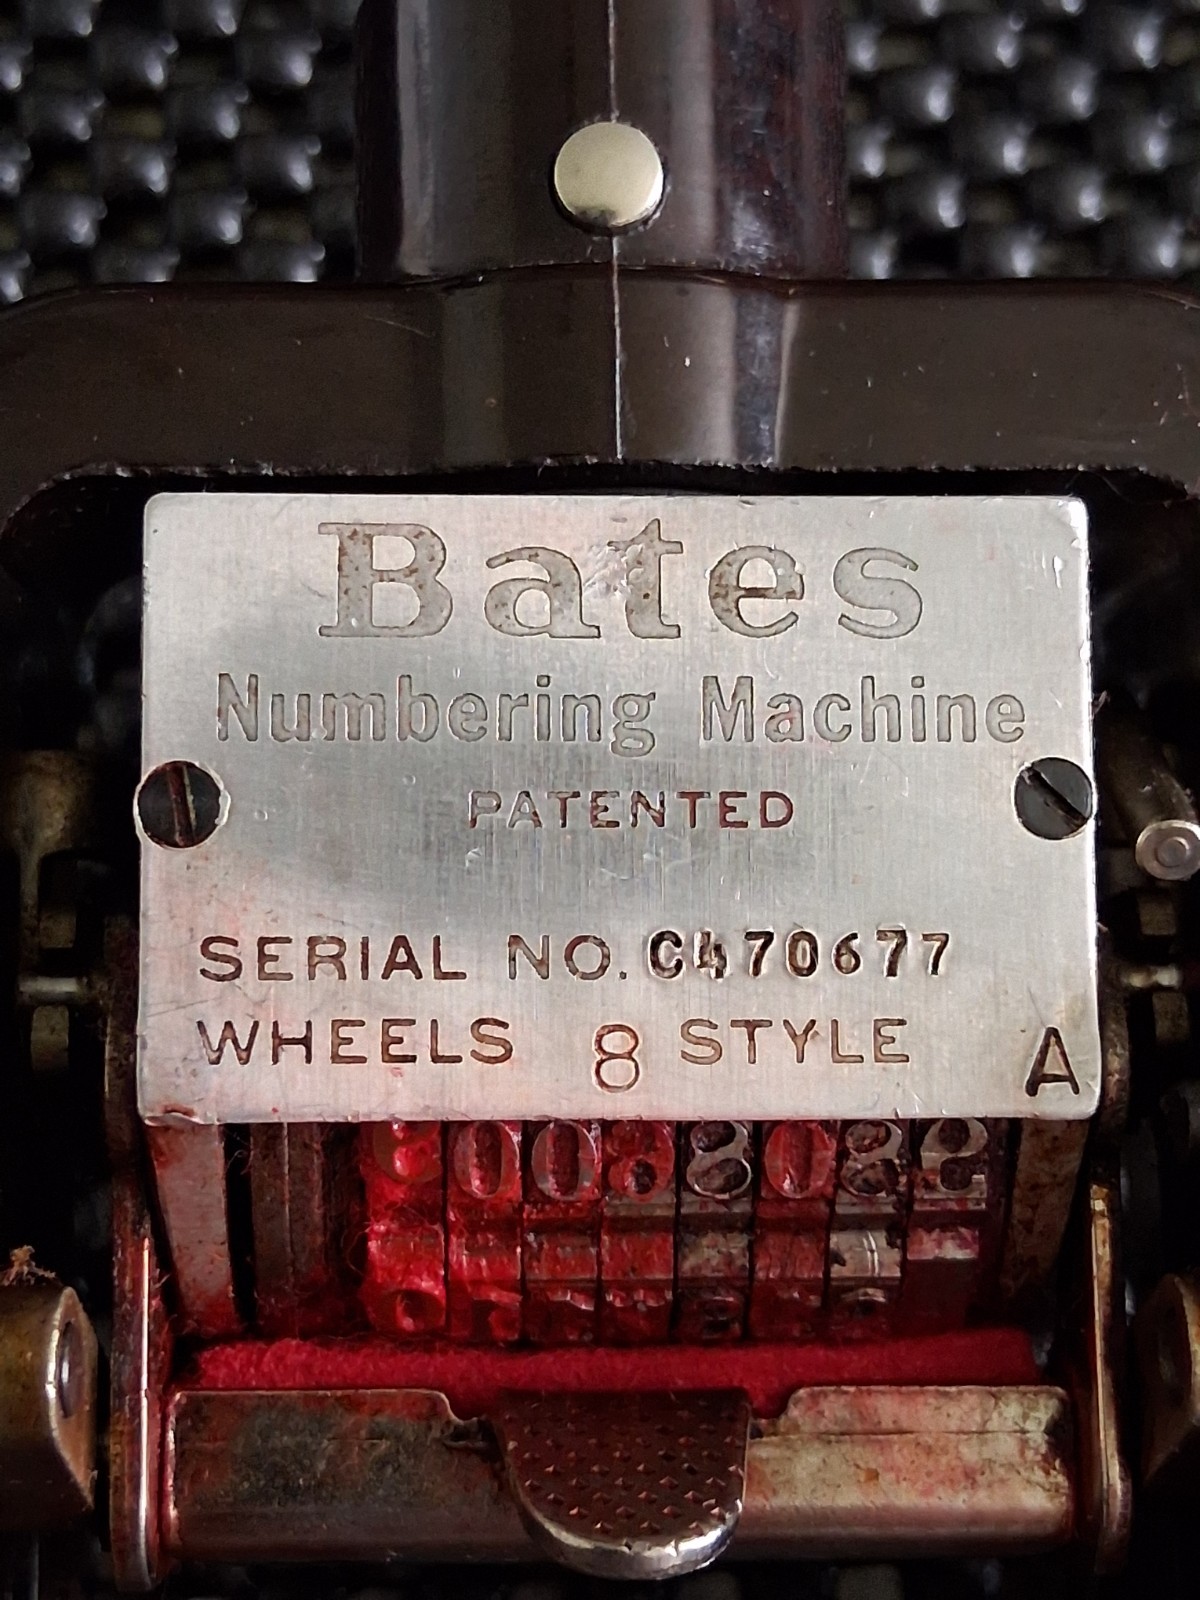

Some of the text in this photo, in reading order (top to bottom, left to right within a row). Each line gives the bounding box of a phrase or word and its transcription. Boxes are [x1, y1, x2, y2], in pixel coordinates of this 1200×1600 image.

[318, 517, 922, 640] Bates
[216, 673, 1026, 756] Numbering Machine
[468, 788, 794, 829] PATENTED
[199, 928, 952, 982] SERIAL NO. C470677
[198, 1017, 1080, 1097] WHEELS 8 STYLE A
